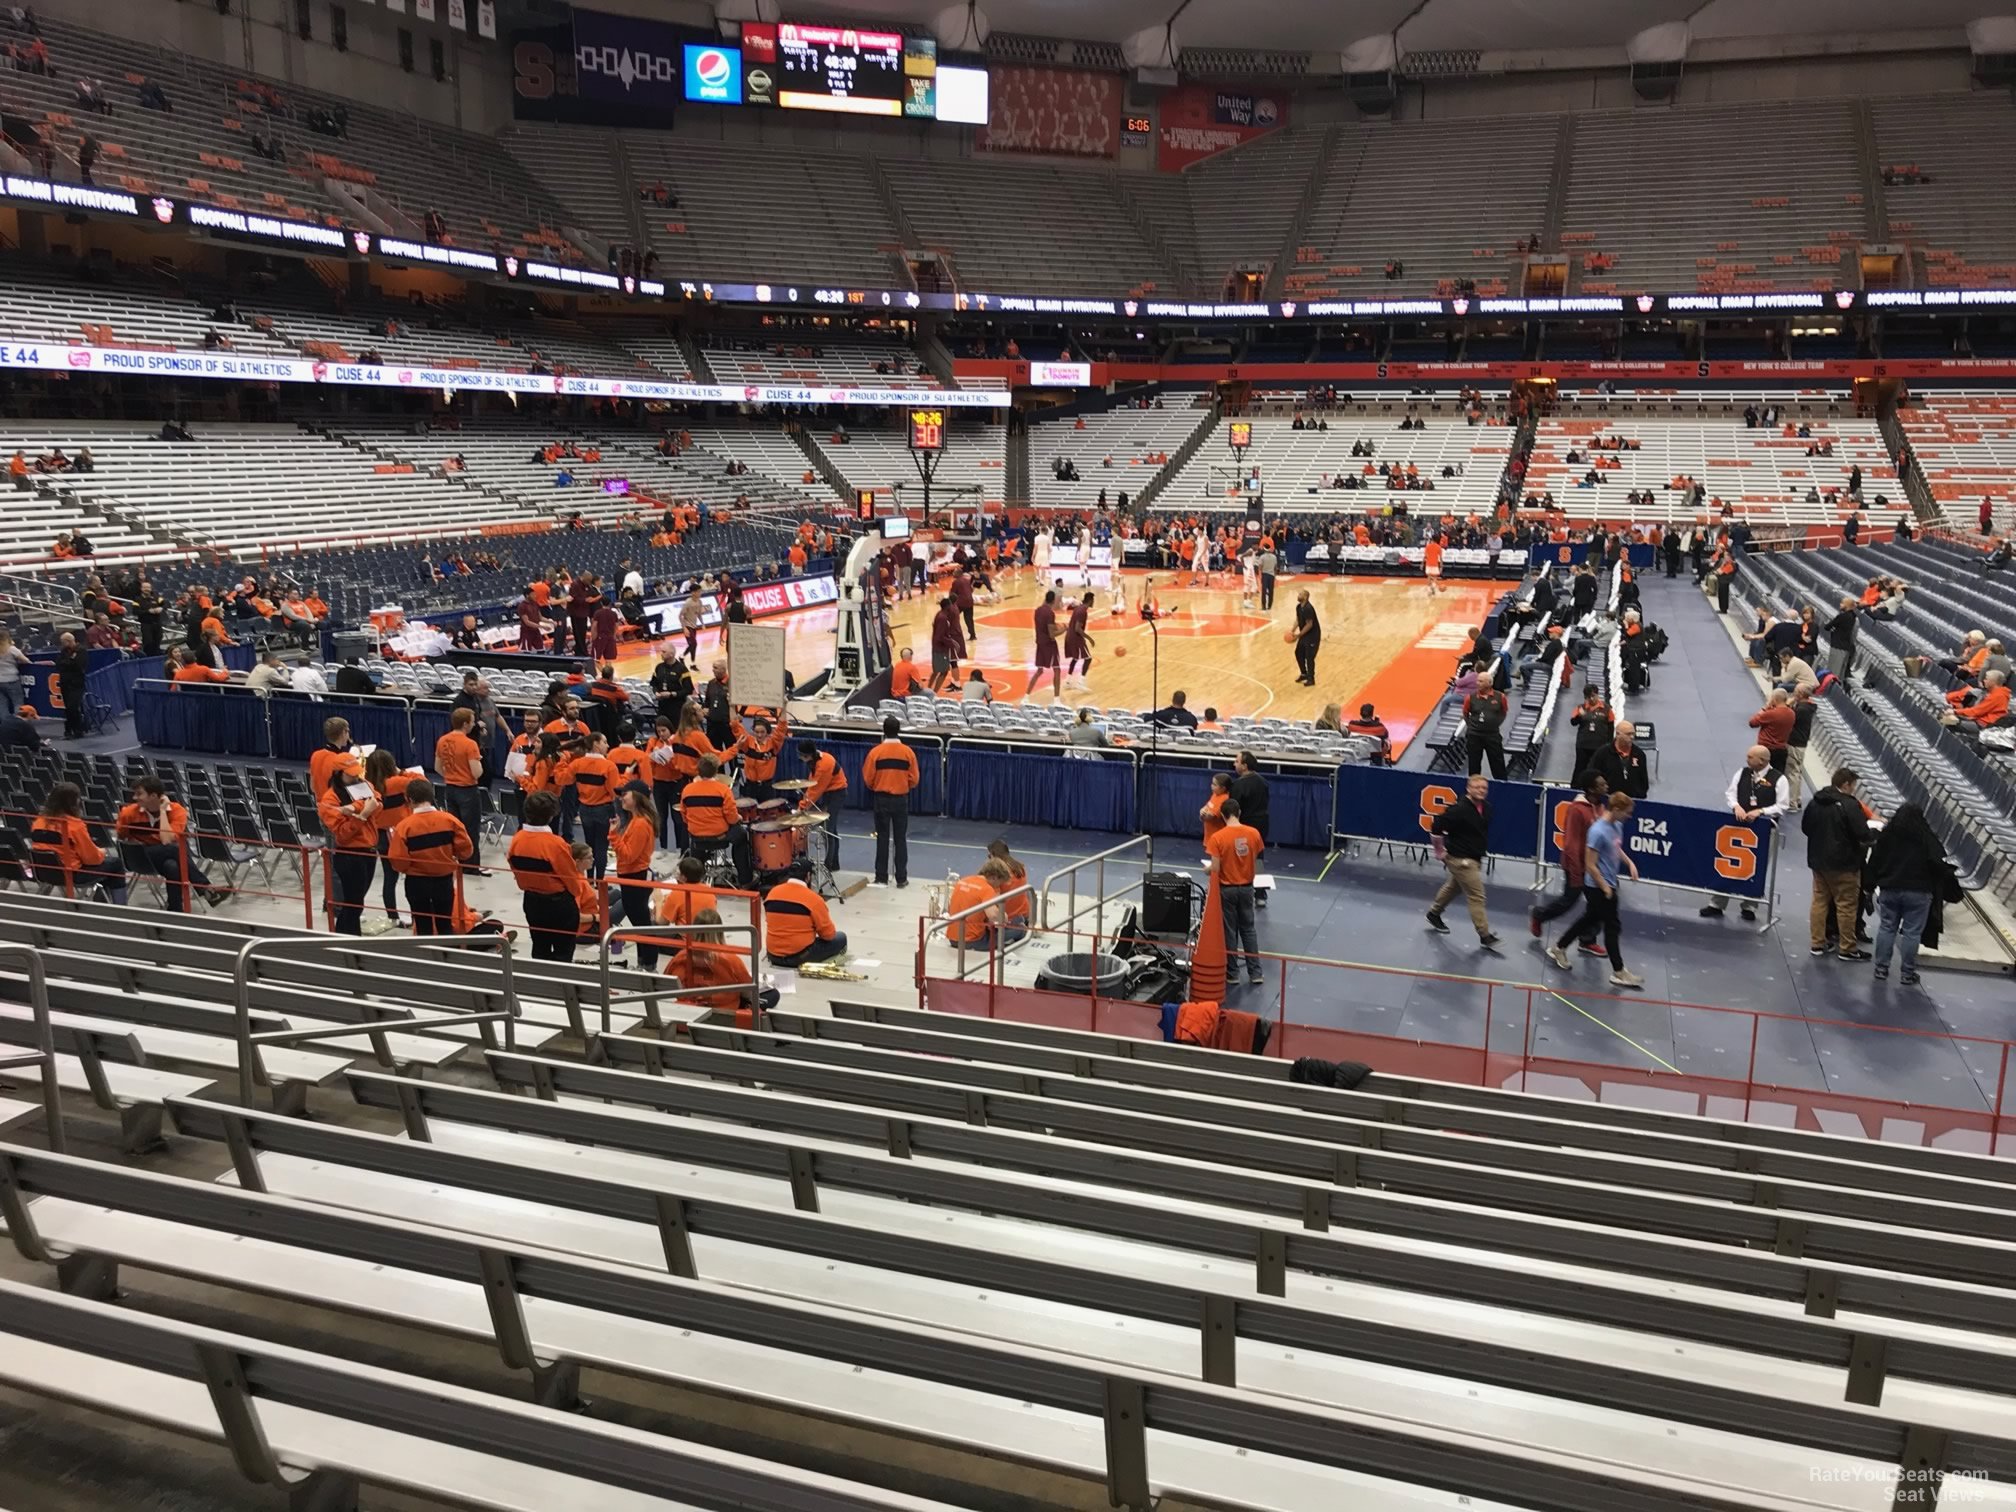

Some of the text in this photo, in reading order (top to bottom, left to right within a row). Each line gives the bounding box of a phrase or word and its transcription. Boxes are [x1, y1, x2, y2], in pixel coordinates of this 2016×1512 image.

[910, 78, 930, 90] TAKE
[914, 88, 926, 97] ME
[914, 96, 926, 104] TO
[1217, 95, 1251, 108] United
[905, 103, 934, 116] CROUSE
[1231, 110, 1251, 124] Way
[1128, 118, 1150, 131] 6:06
[848, 292, 864, 303] 1ST
[16, 348, 39, 364] 44
[104, 354, 292, 377] PROUD SPONSOR OF SU ATHLETICS
[1530, 367, 1541, 376] 114
[1744, 362, 1757, 370] NEW
[1758, 362, 1779, 370] YORK'S
[1874, 365, 1886, 376] 115
[336, 367, 381, 381] CUSE 44
[420, 372, 446, 384] PROUD
[448, 375, 482, 386] SPONSOR
[506, 378, 540, 389] ATHLETICS
[568, 380, 599, 391] CUSE 44
[766, 389, 811, 400] CUSE 44
[850, 392, 989, 403] PROUD SPONSOR OF SU ATHLETICS
[916, 425, 939, 446] 30
[1559, 546, 1571, 563] S
[793, 583, 805, 605] S
[1635, 725, 1651, 733] EVENT
[1638, 817, 1668, 837] 124
[1235, 837, 1249, 857] 5
[1630, 835, 1673, 857] ONLY
[1714, 825, 1759, 881] S
